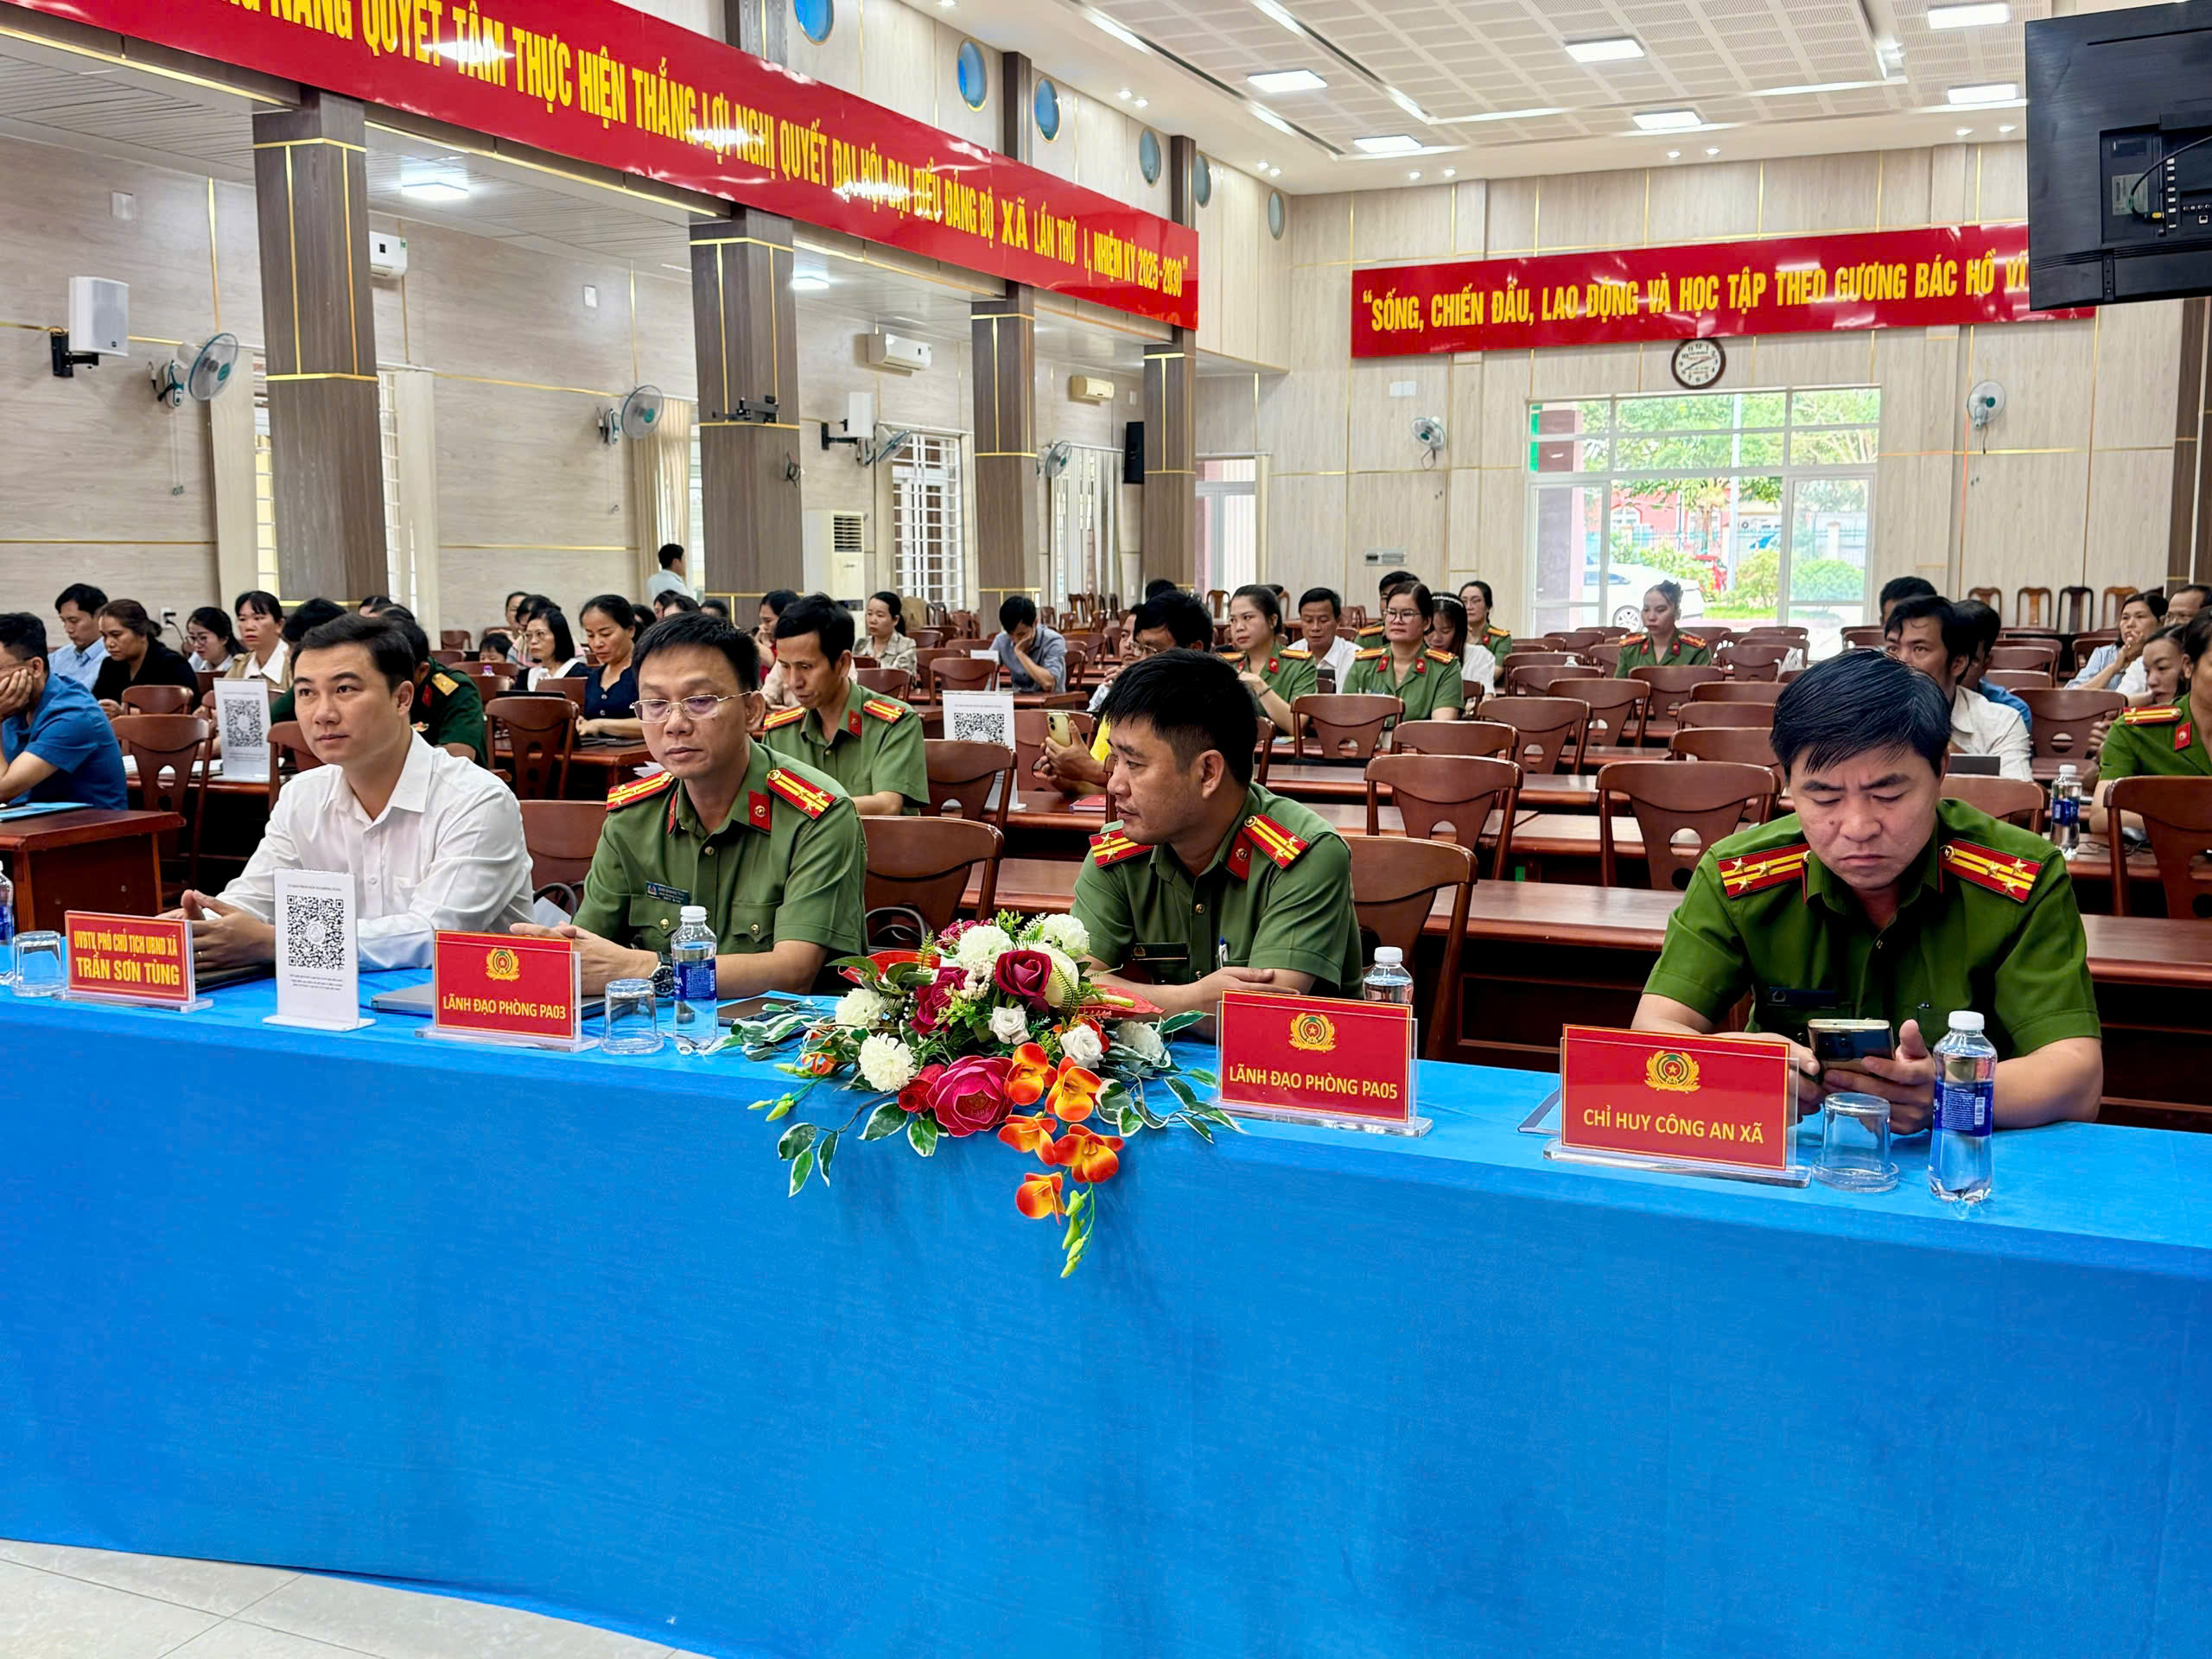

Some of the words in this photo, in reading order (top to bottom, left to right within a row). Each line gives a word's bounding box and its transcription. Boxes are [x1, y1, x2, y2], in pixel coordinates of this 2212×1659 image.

[452, 0, 506, 87] TÂM
[512, 26, 572, 113] THỰC
[577, 46, 626, 129] HIỆN
[632, 56, 696, 145] THẮNG
[702, 92, 730, 164] LỢI
[735, 104, 775, 180] NGHỊ
[780, 118, 827, 187] QUYẾT
[887, 158, 910, 219] ĐẠI
[944, 168, 977, 234] ĐẢNG
[979, 186, 994, 249] BỘ
[1001, 196, 1028, 251] XÃ
[1094, 230, 1122, 283] NHIỆM
[1124, 238, 1136, 283] KỲ
[1431, 283, 1484, 327] CHIẾN
[1541, 284, 1579, 321] LAO
[1586, 276, 1638, 323] ĐỘNG
[1647, 271, 1671, 315] VÀ
[1679, 275, 1719, 317] HỌC
[1727, 266, 1767, 315] TẬP
[1775, 268, 1827, 307] THEO
[1834, 261, 1907, 302] GƯƠNG
[1915, 254, 1957, 299] BÁC
[1965, 248, 1996, 296] HỒ
[146, 936, 167, 956] UBND
[76, 951, 111, 980] TRẦN
[113, 959, 142, 982] SƠN
[144, 958, 181, 986] TÙNG
[442, 993, 472, 1012] LÃNH
[474, 997, 497, 1016] ĐẠO
[499, 998, 537, 1017] PHÒNG
[539, 1003, 567, 1020] PA03
[1230, 1063, 1267, 1085] LÃNH
[1270, 1070, 1302, 1090] ĐẠO
[1306, 1072, 1358, 1096] PHÒNG
[1363, 1080, 1398, 1100] PA05
[1583, 1104, 1611, 1128] CHỈ
[1616, 1111, 1651, 1132] HUY
[1655, 1113, 1705, 1138] CÔNG
[1709, 1123, 1735, 1141] AN
[1739, 1122, 1764, 1144] XÃ
